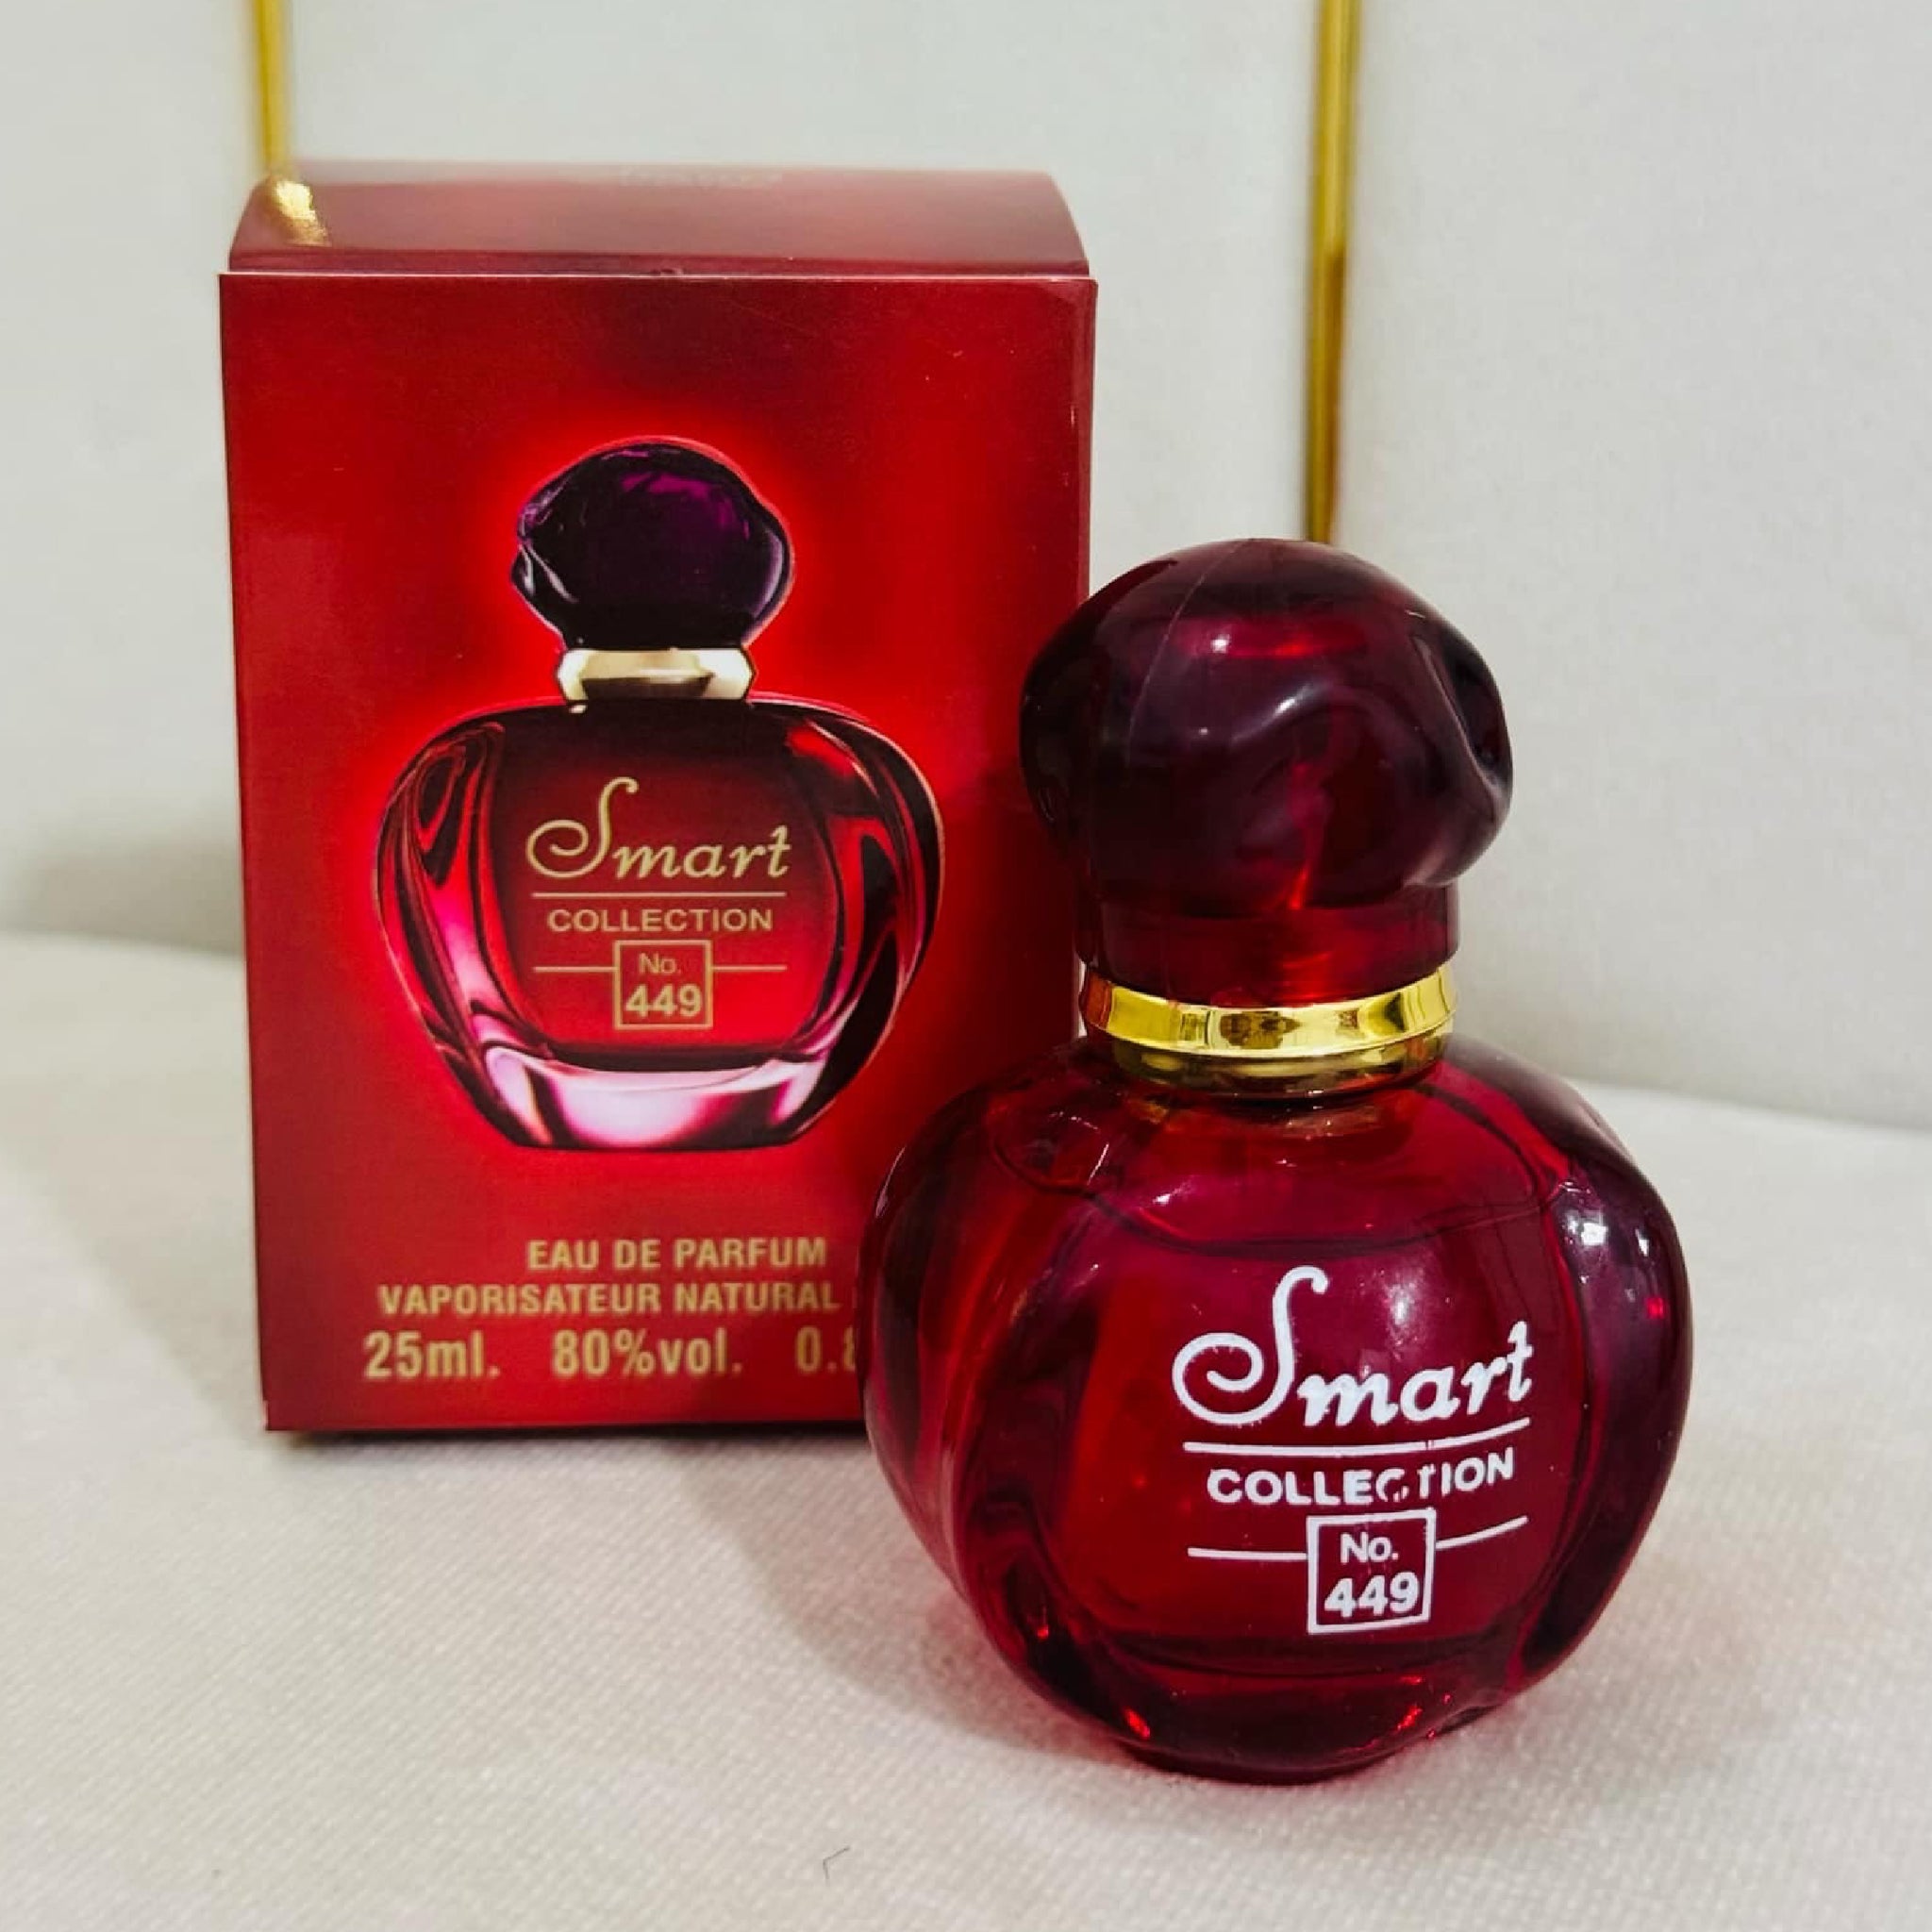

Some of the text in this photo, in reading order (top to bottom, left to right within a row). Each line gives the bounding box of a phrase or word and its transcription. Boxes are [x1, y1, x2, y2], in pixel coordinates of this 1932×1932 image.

[525, 776, 791, 879] Smart
[547, 908, 773, 932] COLLECTION
[638, 953, 681, 974] No.
[625, 984, 703, 1018] 449
[527, 1238, 826, 1271] EAU DE PARFUM
[379, 1283, 660, 1315] VAPORISATEUR
[675, 1281, 840, 1312] NATURAL
[364, 1330, 500, 1379] 25ml.
[552, 1328, 743, 1376] 80%vol.
[1172, 1265, 1534, 1426] Smart
[1340, 1532, 1399, 1564] No.
[1324, 1572, 1420, 1618] 449
